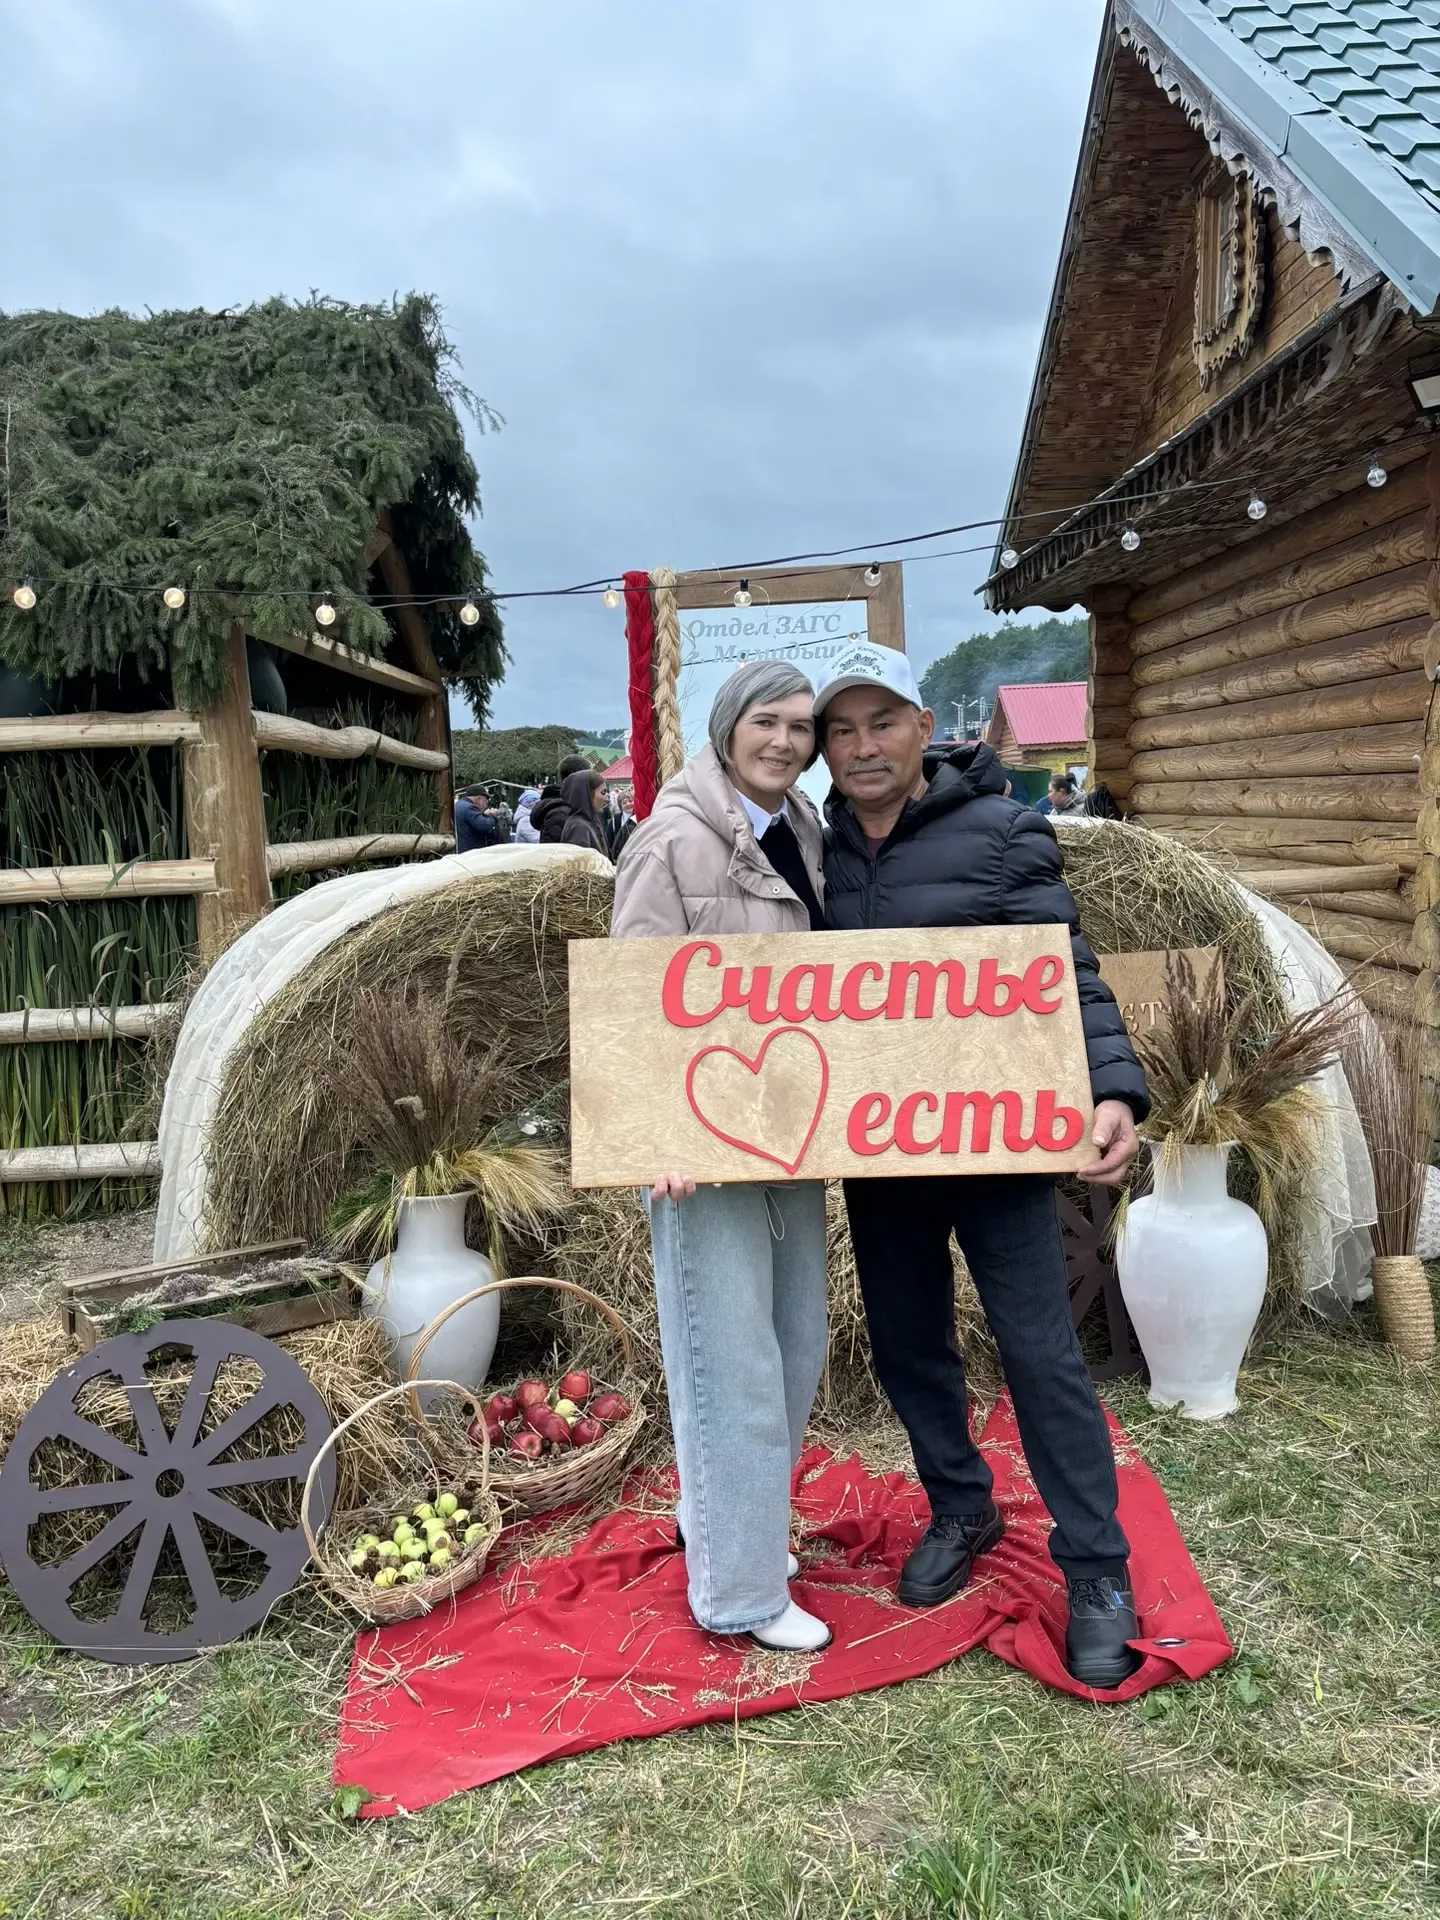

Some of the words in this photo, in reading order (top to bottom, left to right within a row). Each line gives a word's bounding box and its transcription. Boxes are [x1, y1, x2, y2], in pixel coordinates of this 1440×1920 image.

[687, 617, 769, 637] Отдел
[776, 615, 841, 634] ЗАГС
[661, 940, 1064, 1028] Счастье
[846, 1089, 1084, 1155] есть
